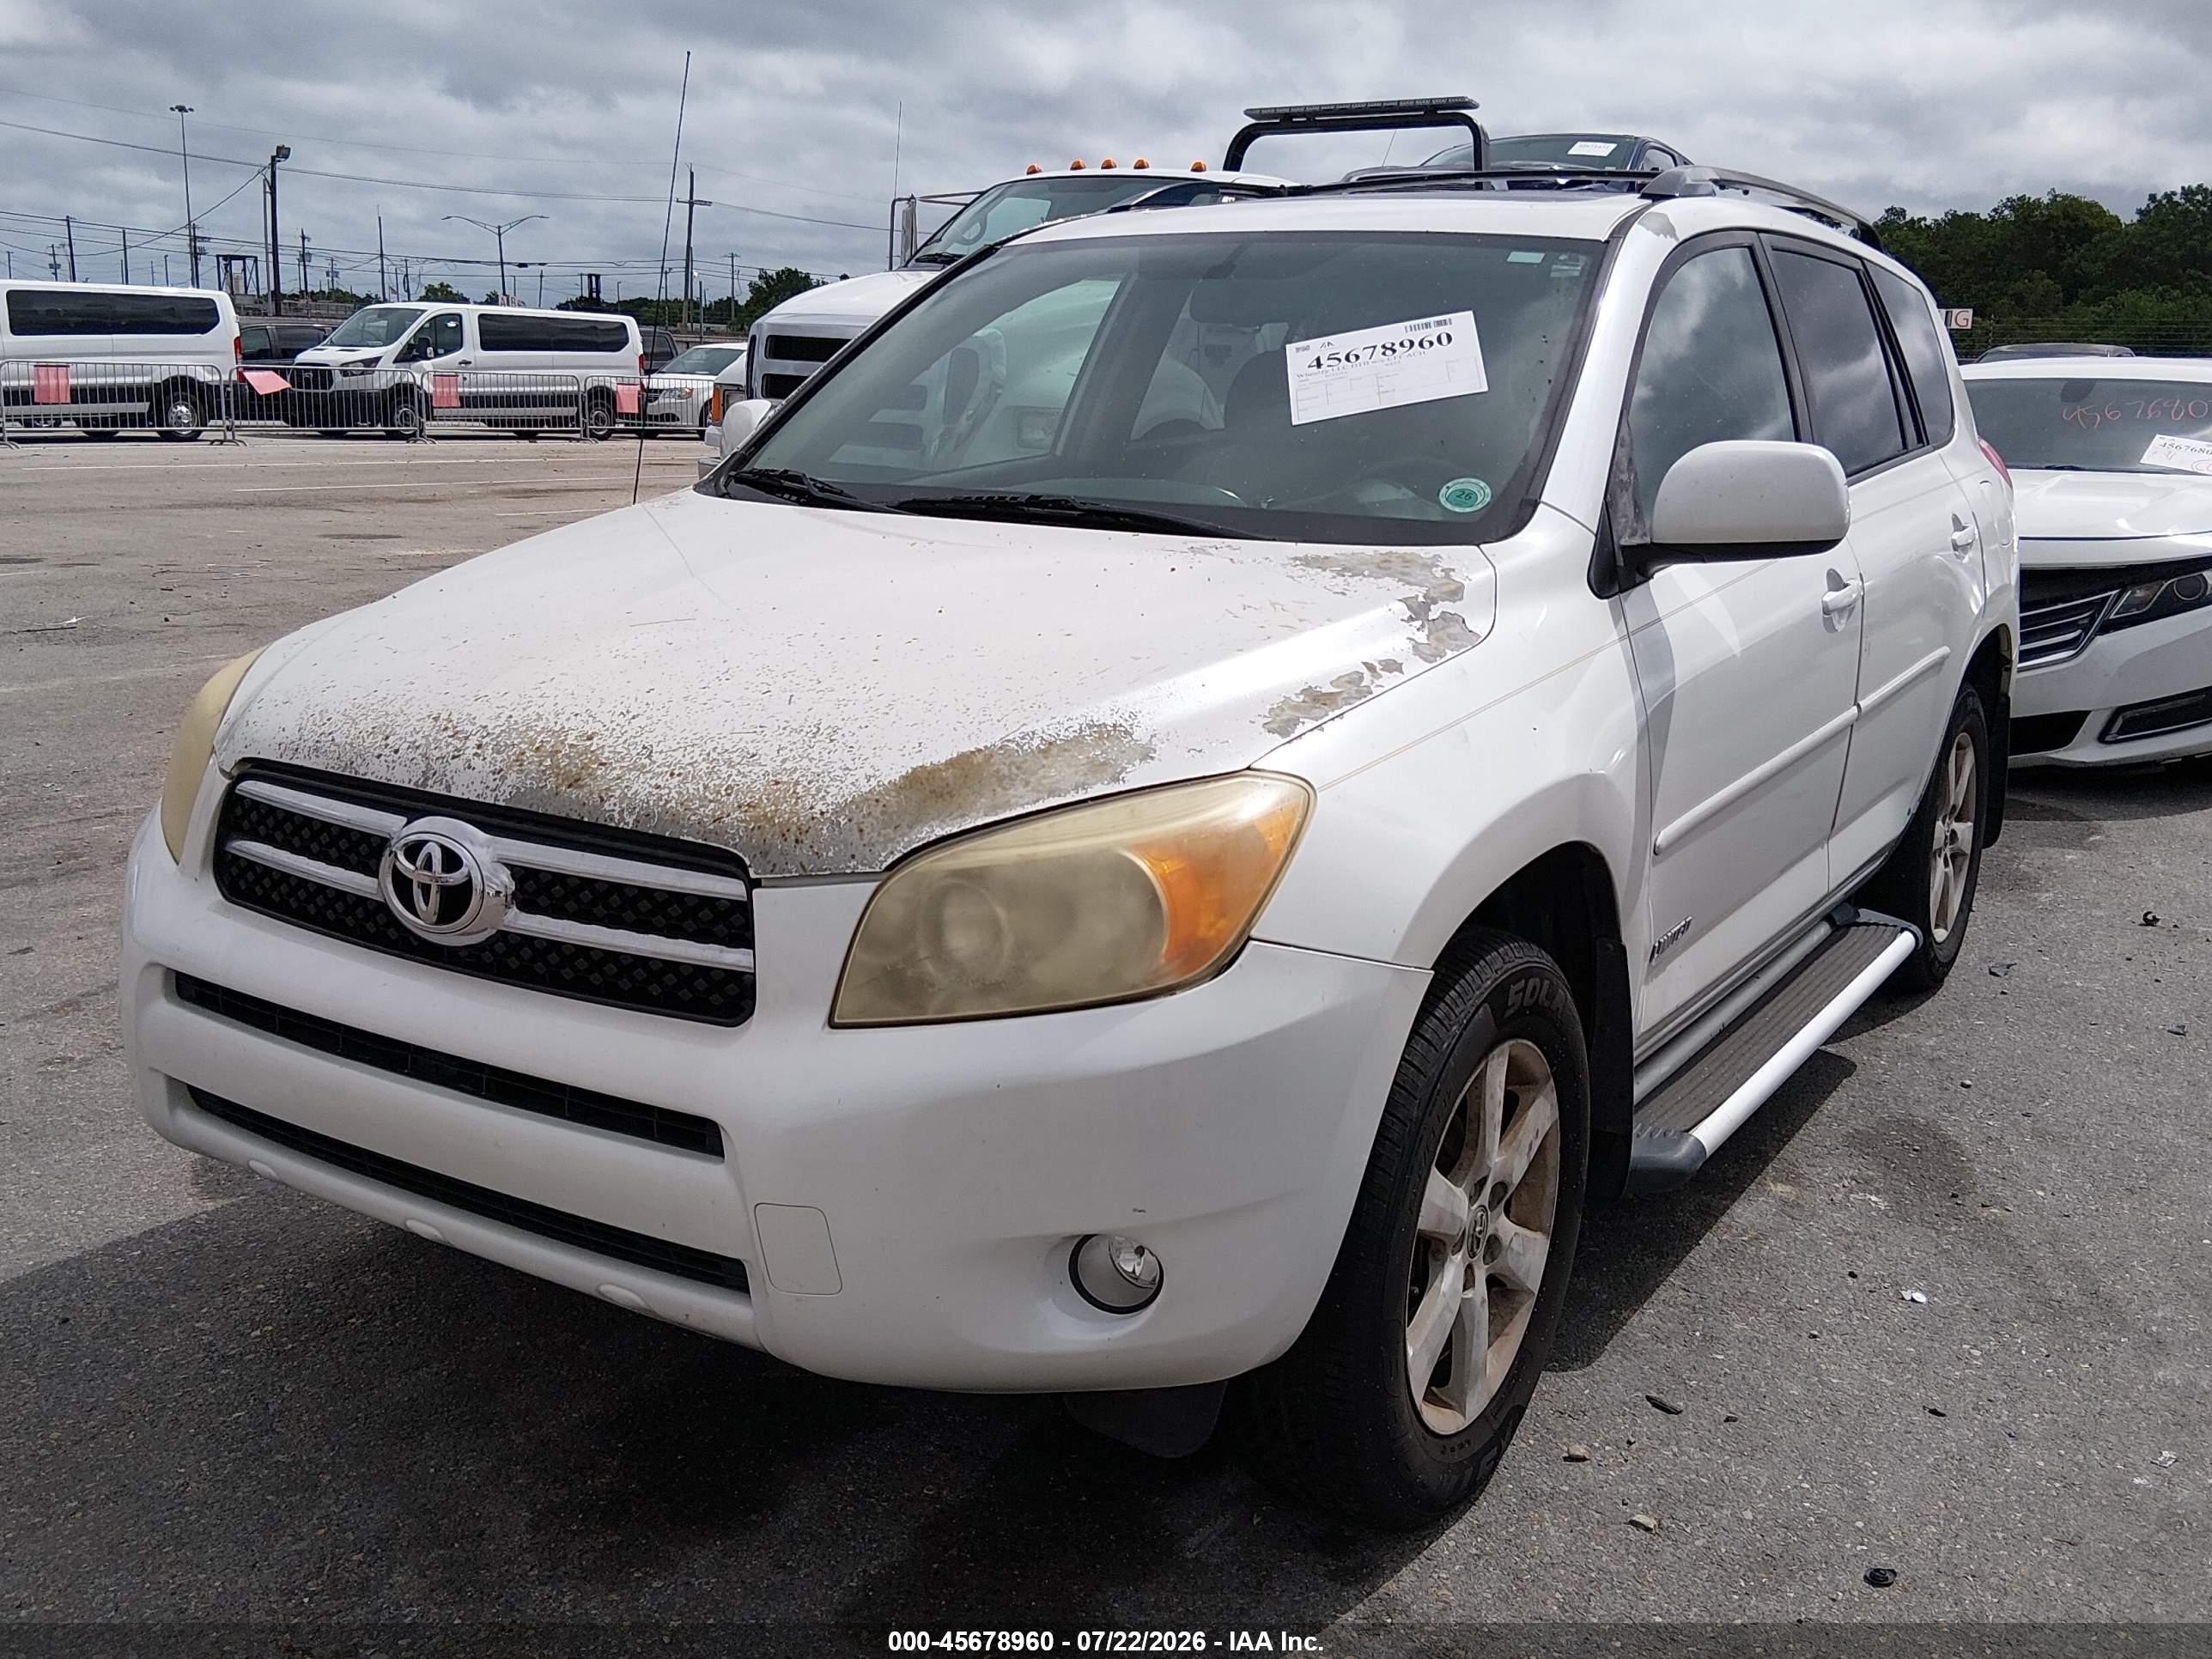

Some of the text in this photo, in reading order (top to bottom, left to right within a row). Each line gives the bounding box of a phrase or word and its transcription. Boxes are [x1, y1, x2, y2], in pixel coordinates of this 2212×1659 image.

[1954, 310, 1969, 327] G
[1307, 331, 1454, 370] 45678960
[2063, 398, 2212, 429] 4567680
